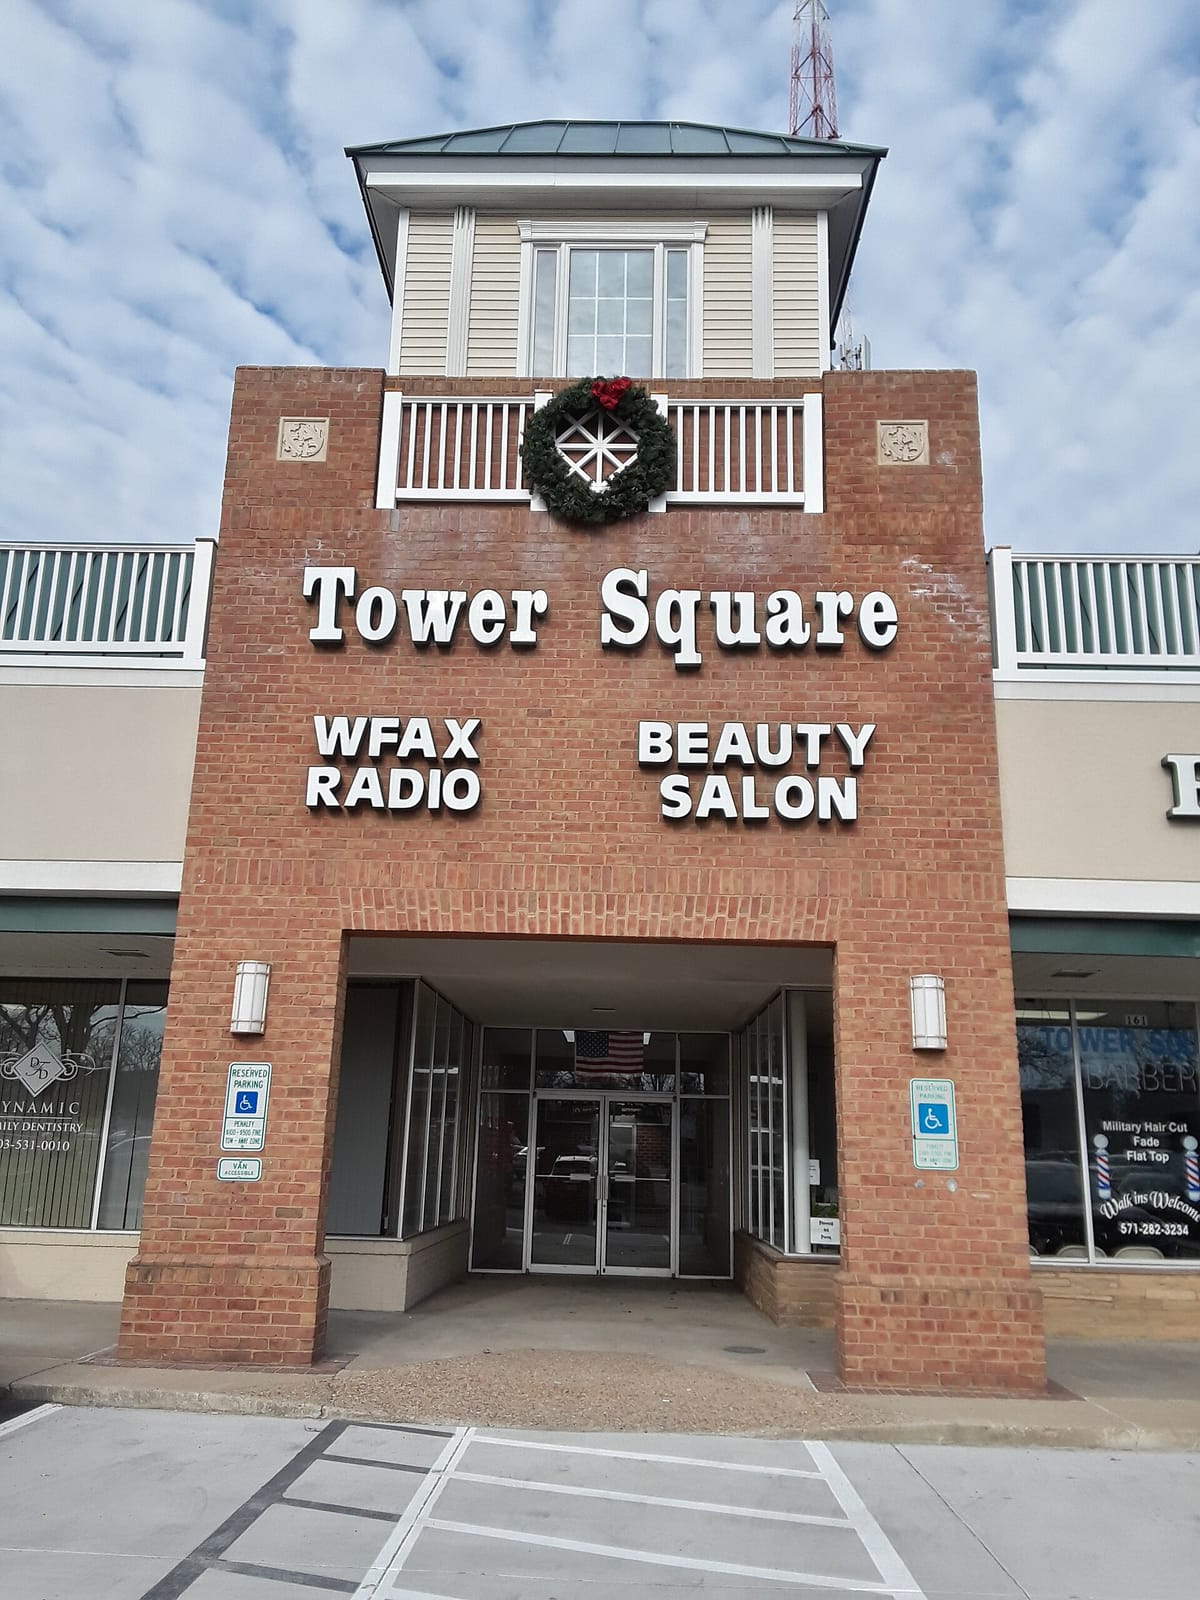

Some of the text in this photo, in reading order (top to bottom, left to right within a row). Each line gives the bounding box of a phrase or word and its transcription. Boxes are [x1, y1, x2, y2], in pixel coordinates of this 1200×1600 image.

[303, 566, 898, 668] Tower Square
[313, 715, 481, 760] WFAX
[638, 720, 877, 768] BEAUTY
[306, 766, 480, 812] RADIO
[661, 774, 858, 822] SALON
[1127, 1015, 1146, 1025] 161
[1040, 1026, 1137, 1053] TOWER
[232, 1069, 268, 1078] RESERVED
[1087, 1062, 1198, 1093] BARBER
[234, 1080, 264, 1089] PARKING
[0, 1121, 84, 1133] ILY DENTISTRY
[234, 1120, 255, 1128] PENALTY
[1103, 1121, 1188, 1134] Military Hair Cut
[1133, 1136, 1160, 1147] Fade
[1126, 1150, 1170, 1164] Flat Top
[1100, 1191, 1200, 1222] Walk ins Welcome
[1120, 1223, 1189, 1236] 571-282-3234
